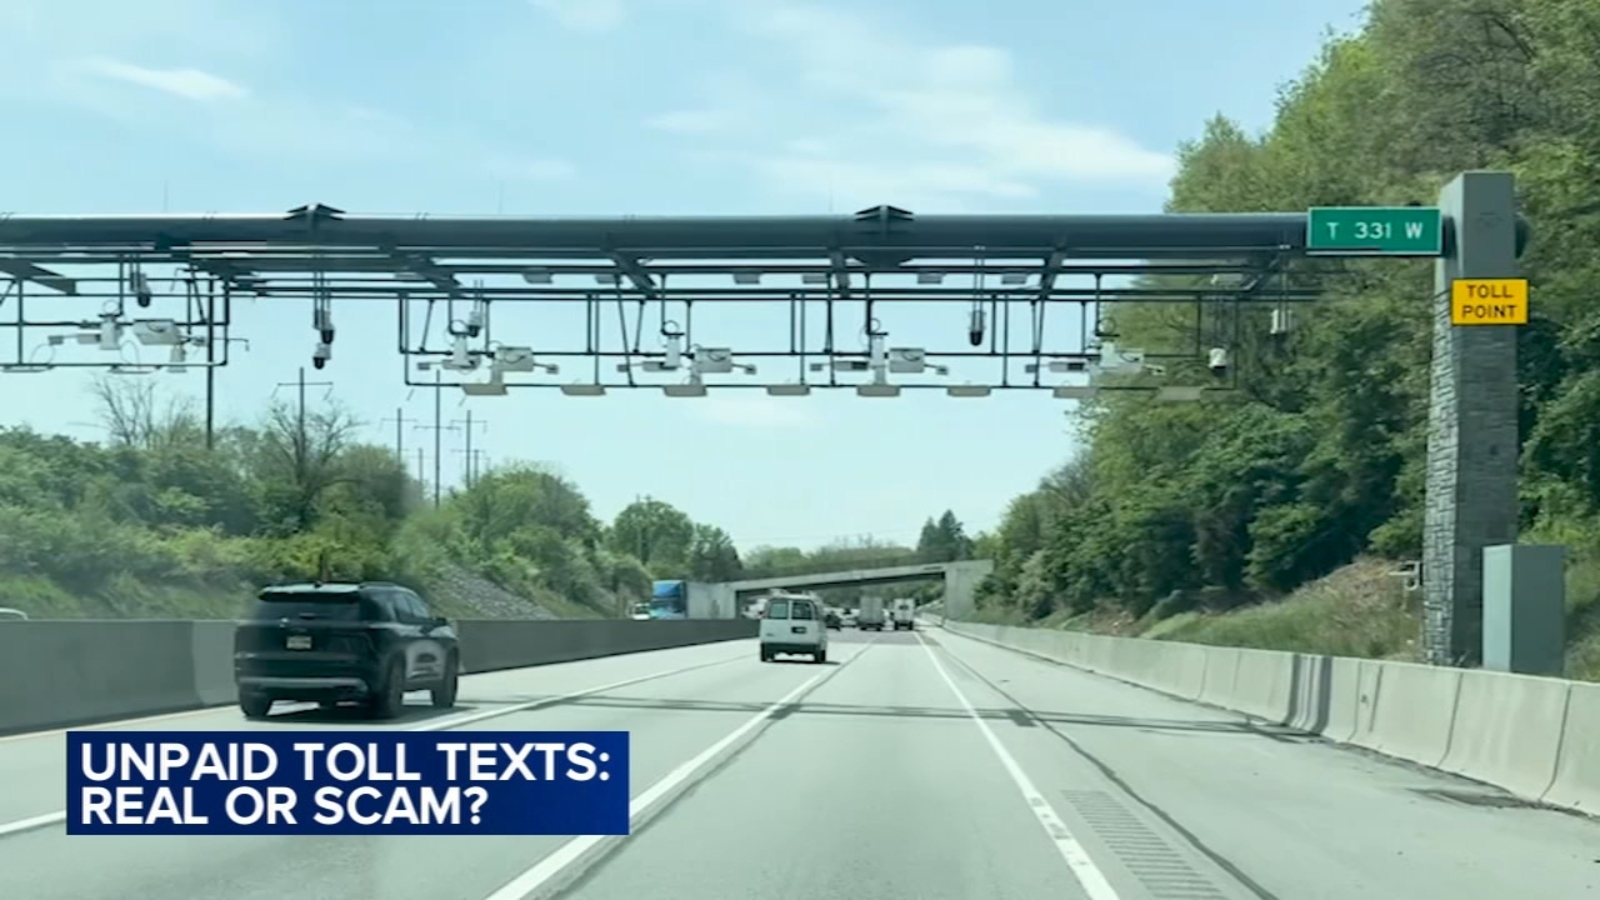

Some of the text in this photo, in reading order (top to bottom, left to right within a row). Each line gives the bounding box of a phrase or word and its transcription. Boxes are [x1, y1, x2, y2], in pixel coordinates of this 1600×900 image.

[1326, 222, 1423, 240] T 331 W
[1466, 284, 1514, 299] TOLL
[1462, 304, 1517, 319] POINT
